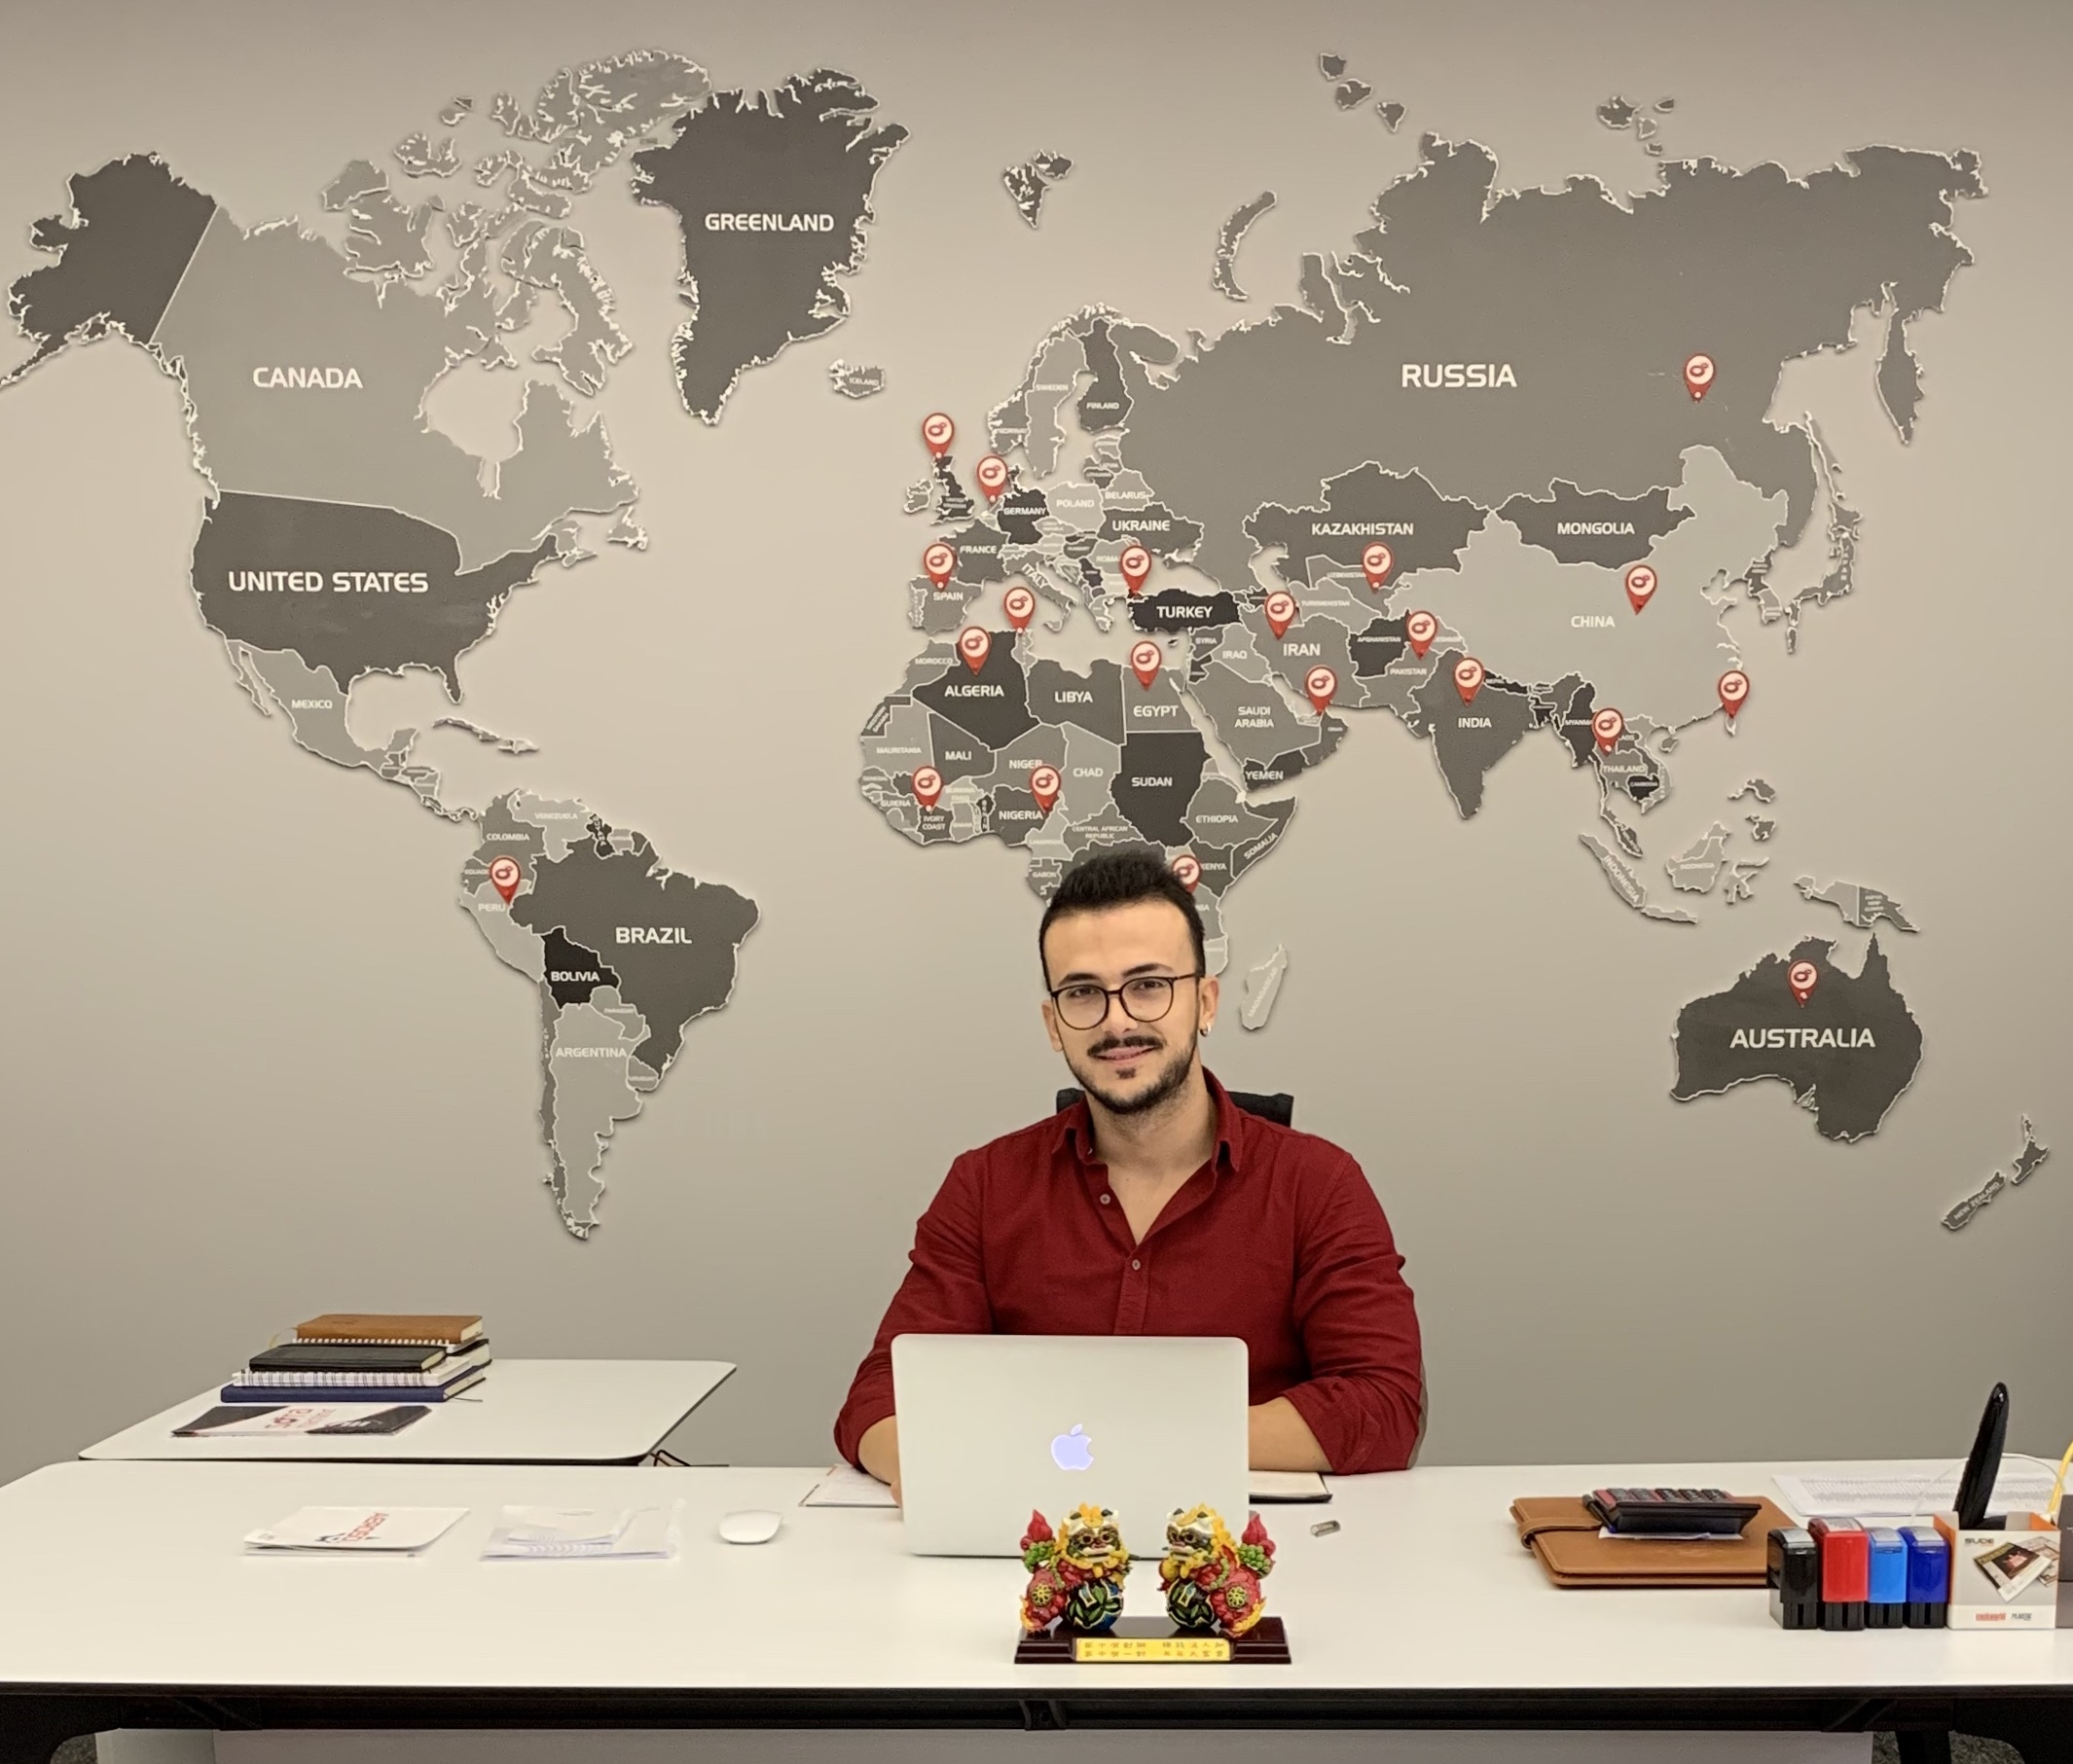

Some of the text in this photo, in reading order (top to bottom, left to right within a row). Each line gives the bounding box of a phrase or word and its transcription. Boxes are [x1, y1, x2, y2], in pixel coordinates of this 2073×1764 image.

[705, 213, 835, 232] GREENLAND
[253, 367, 363, 388] CANADA
[1401, 364, 1516, 388] RUSSIA
[1112, 520, 1171, 532] UKRAINE
[1312, 522, 1414, 535] KAZAKHISTAN
[1557, 522, 1635, 535] MONGOLIA
[1022, 562, 1048, 589] ITALY
[228, 571, 429, 593] UNITED STATES
[1156, 606, 1213, 619] TURKEY
[1571, 616, 1616, 628] CHINA
[1283, 643, 1321, 656] IRAN
[944, 685, 1004, 697] ALGERIA
[1054, 691, 1093, 702] LIBYA
[291, 700, 332, 709] MEXICO
[1238, 706, 1270, 715] SAUDI
[1133, 705, 1179, 717] EGYPT
[1235, 719, 1274, 728] ARABIA
[1458, 718, 1492, 728] INDIA
[945, 751, 972, 760] MALI
[1009, 760, 1042, 769] NIGER
[1073, 768, 1103, 777] CHAD
[1245, 771, 1284, 779] YEMEN
[1132, 777, 1172, 787] SUDAN
[999, 810, 1044, 820] NIGERIA
[1244, 833, 1278, 859] SOMALIA
[1605, 855, 1639, 903] INDONESIA
[615, 928, 692, 943] BRAZIL
[551, 972, 600, 982] BOLIVIA
[1729, 1028, 1876, 1048] AUSTRALIA
[555, 1047, 628, 1058] ARGENTINA
[1953, 1182, 2000, 1220] NEW ZEALAND
